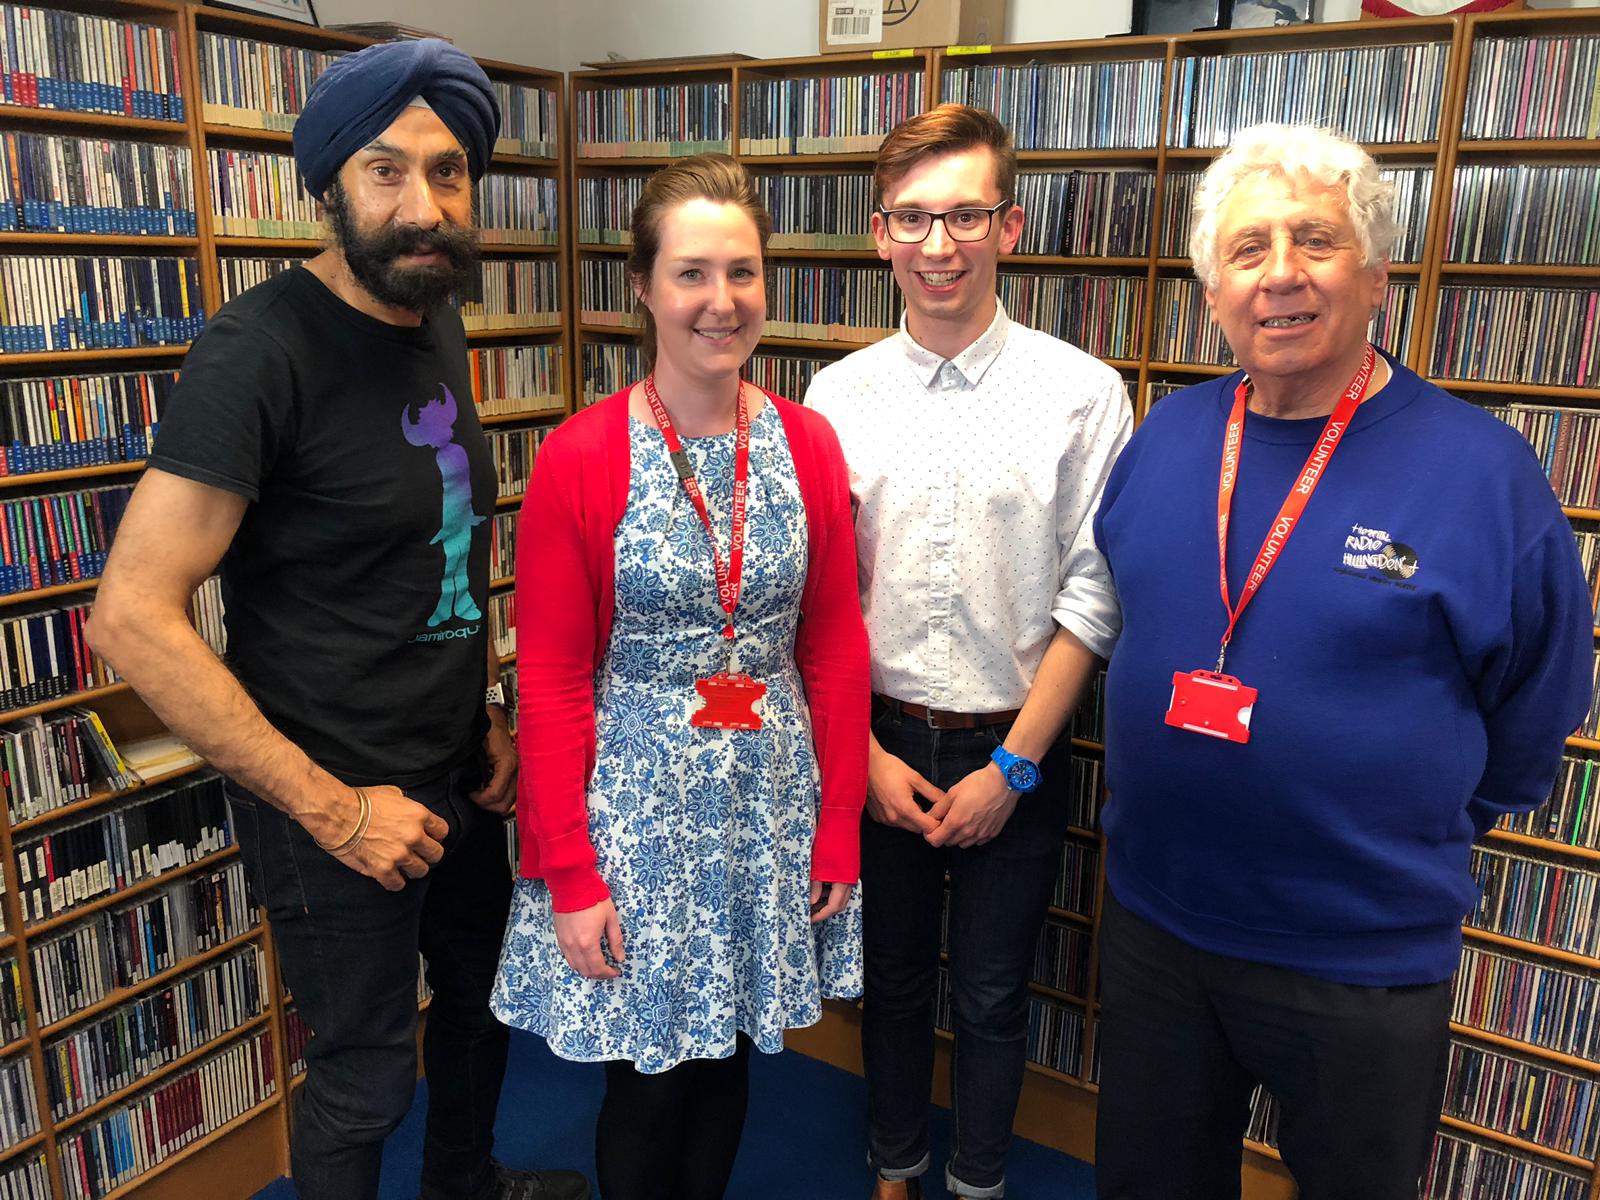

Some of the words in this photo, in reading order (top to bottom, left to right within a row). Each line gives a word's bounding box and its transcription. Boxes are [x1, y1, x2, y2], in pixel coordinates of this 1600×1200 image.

[645, 377, 670, 429] OLUNTEER
[1345, 344, 1372, 400] OLUNTEER
[1222, 421, 1240, 492] VOLUNTEER
[1296, 422, 1344, 494] VOLUNTEER
[733, 480, 746, 551] VOLUNTEER
[1344, 535, 1383, 550] RADIO
[1248, 517, 1294, 591] VOLUNTEER
